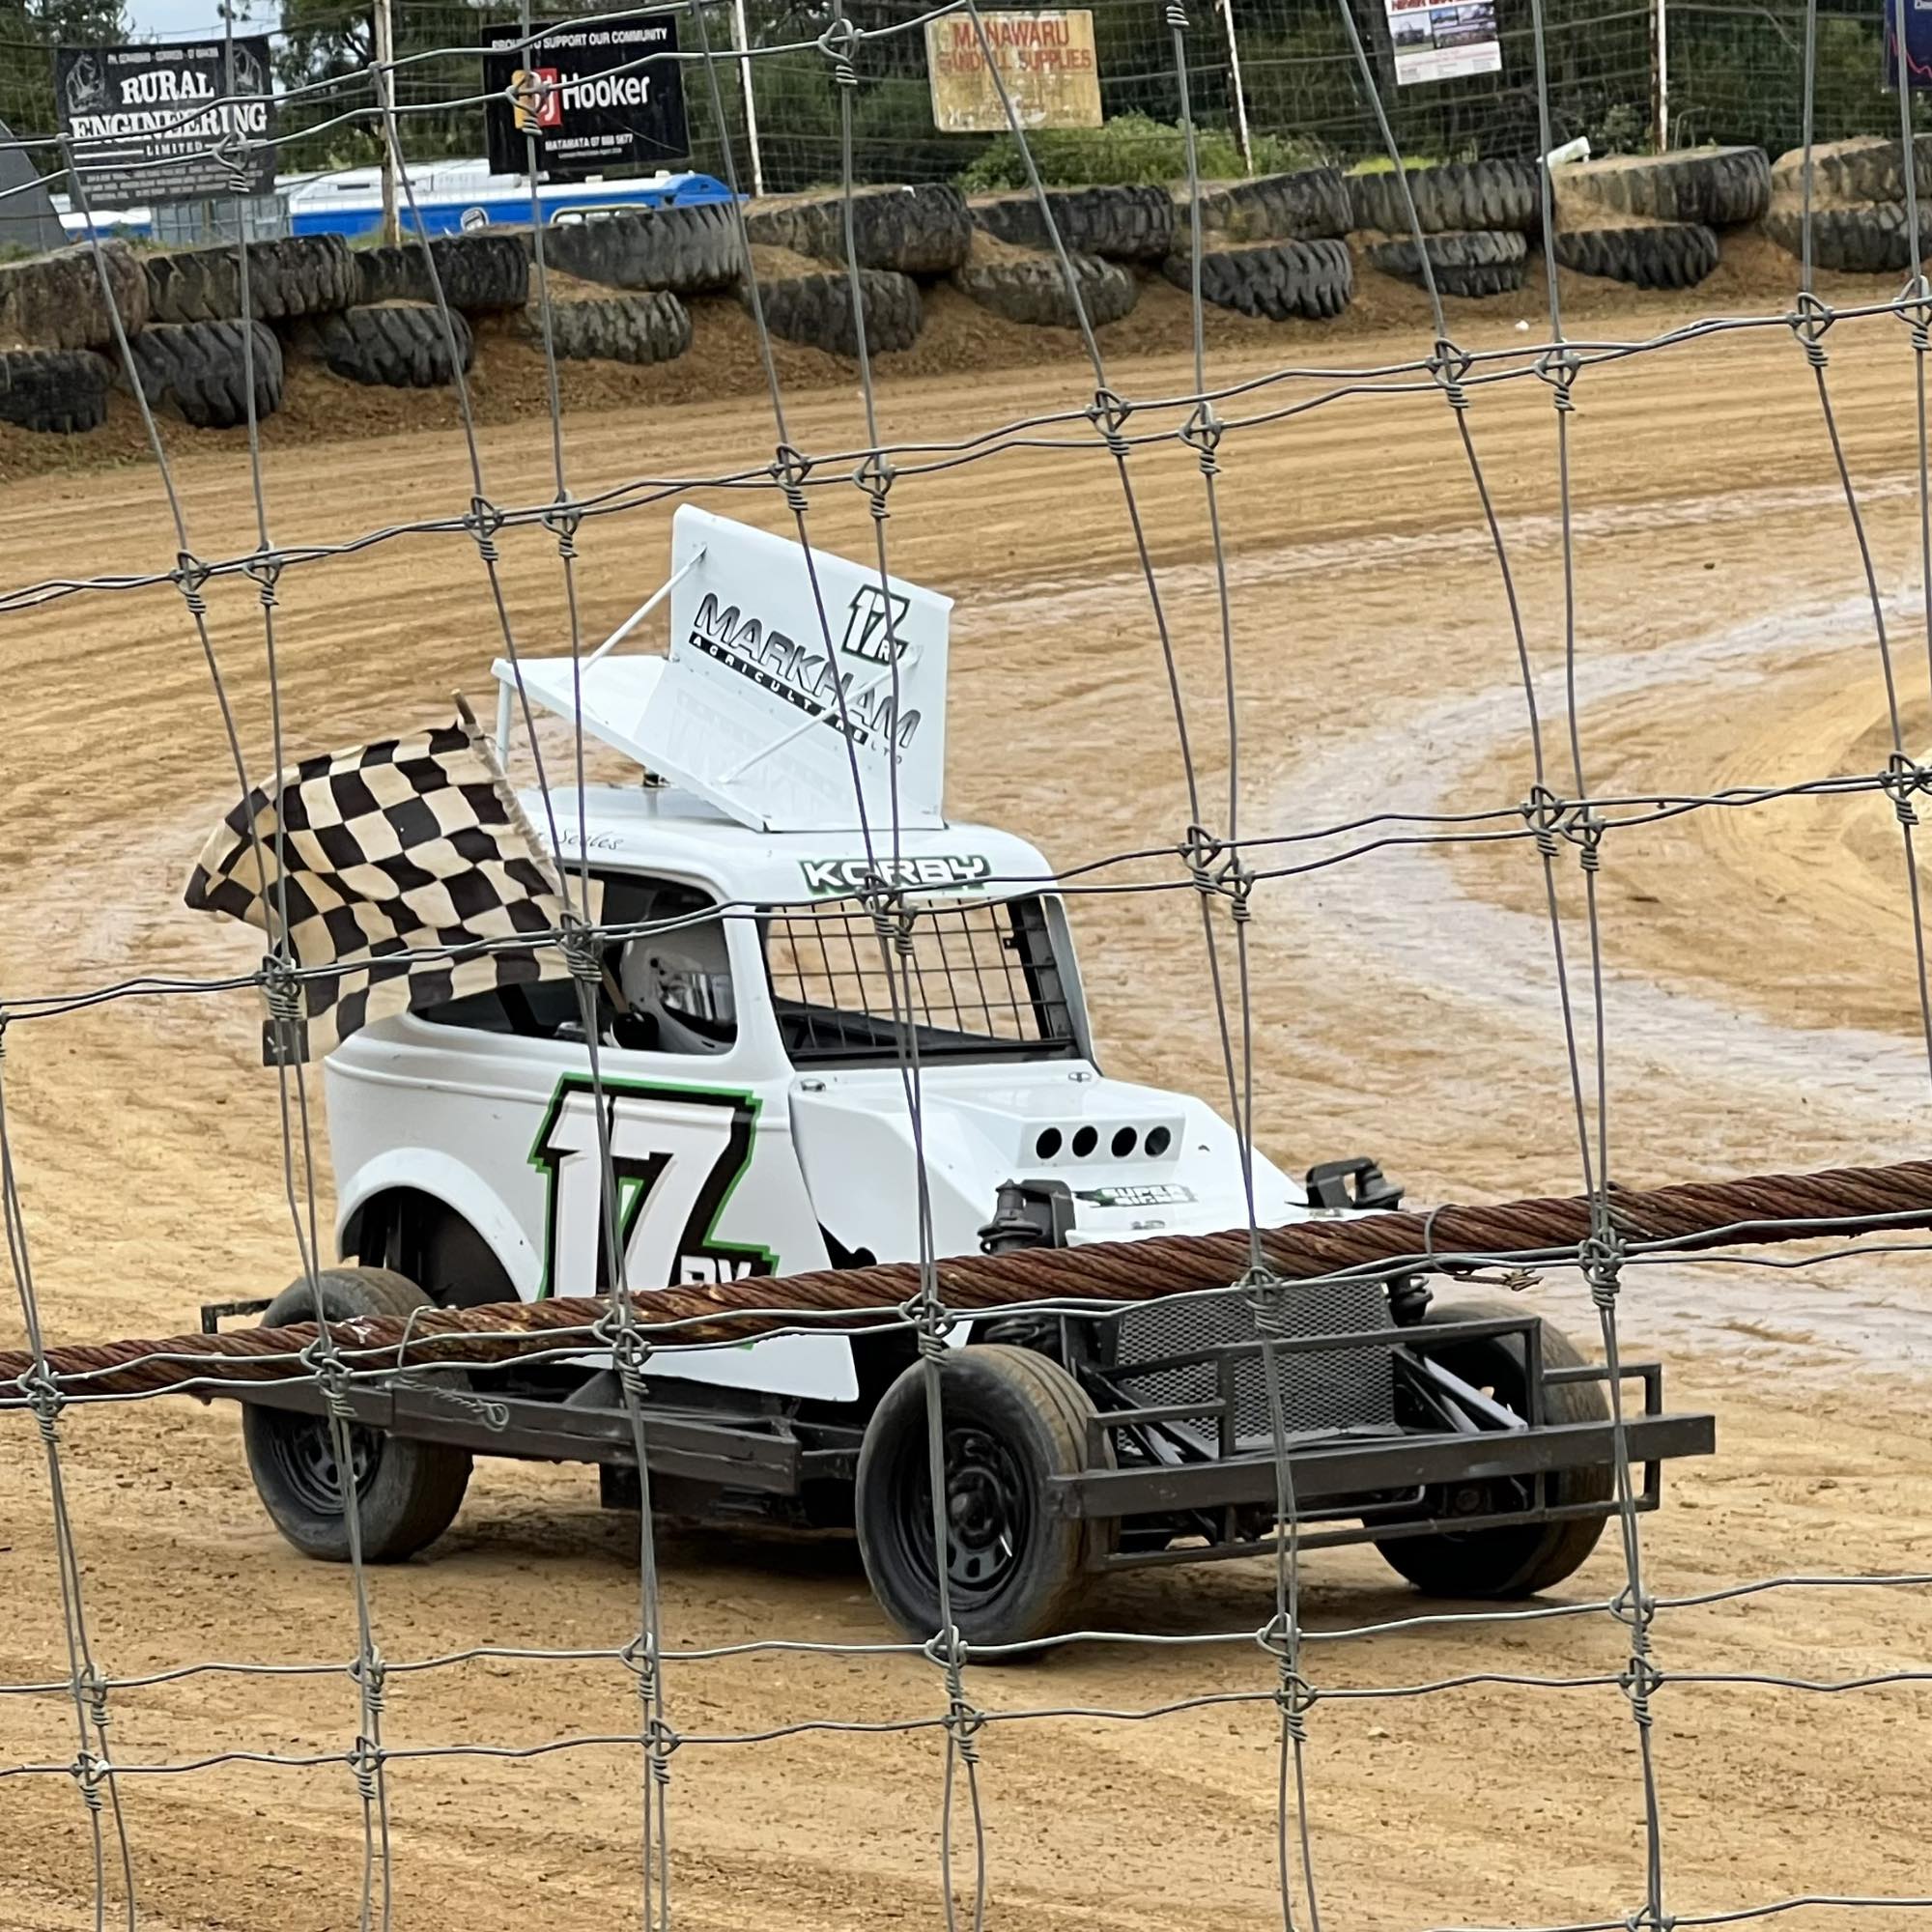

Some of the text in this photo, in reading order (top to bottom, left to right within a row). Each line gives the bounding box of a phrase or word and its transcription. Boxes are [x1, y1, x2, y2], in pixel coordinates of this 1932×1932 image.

[543, 33, 587, 48] SUPPORT
[588, 31, 611, 45] OUR
[611, 27, 668, 44] COMMUNITY
[120, 70, 214, 104] RURAL
[560, 72, 650, 110] Hooker
[69, 101, 268, 145] ENGINEERING
[146, 141, 203, 156] LIMITED
[842, 583, 911, 662] 17
[694, 592, 922, 749] MARKHAM
[800, 856, 990, 893] KORBY
[537, 1082, 749, 1298] 17
